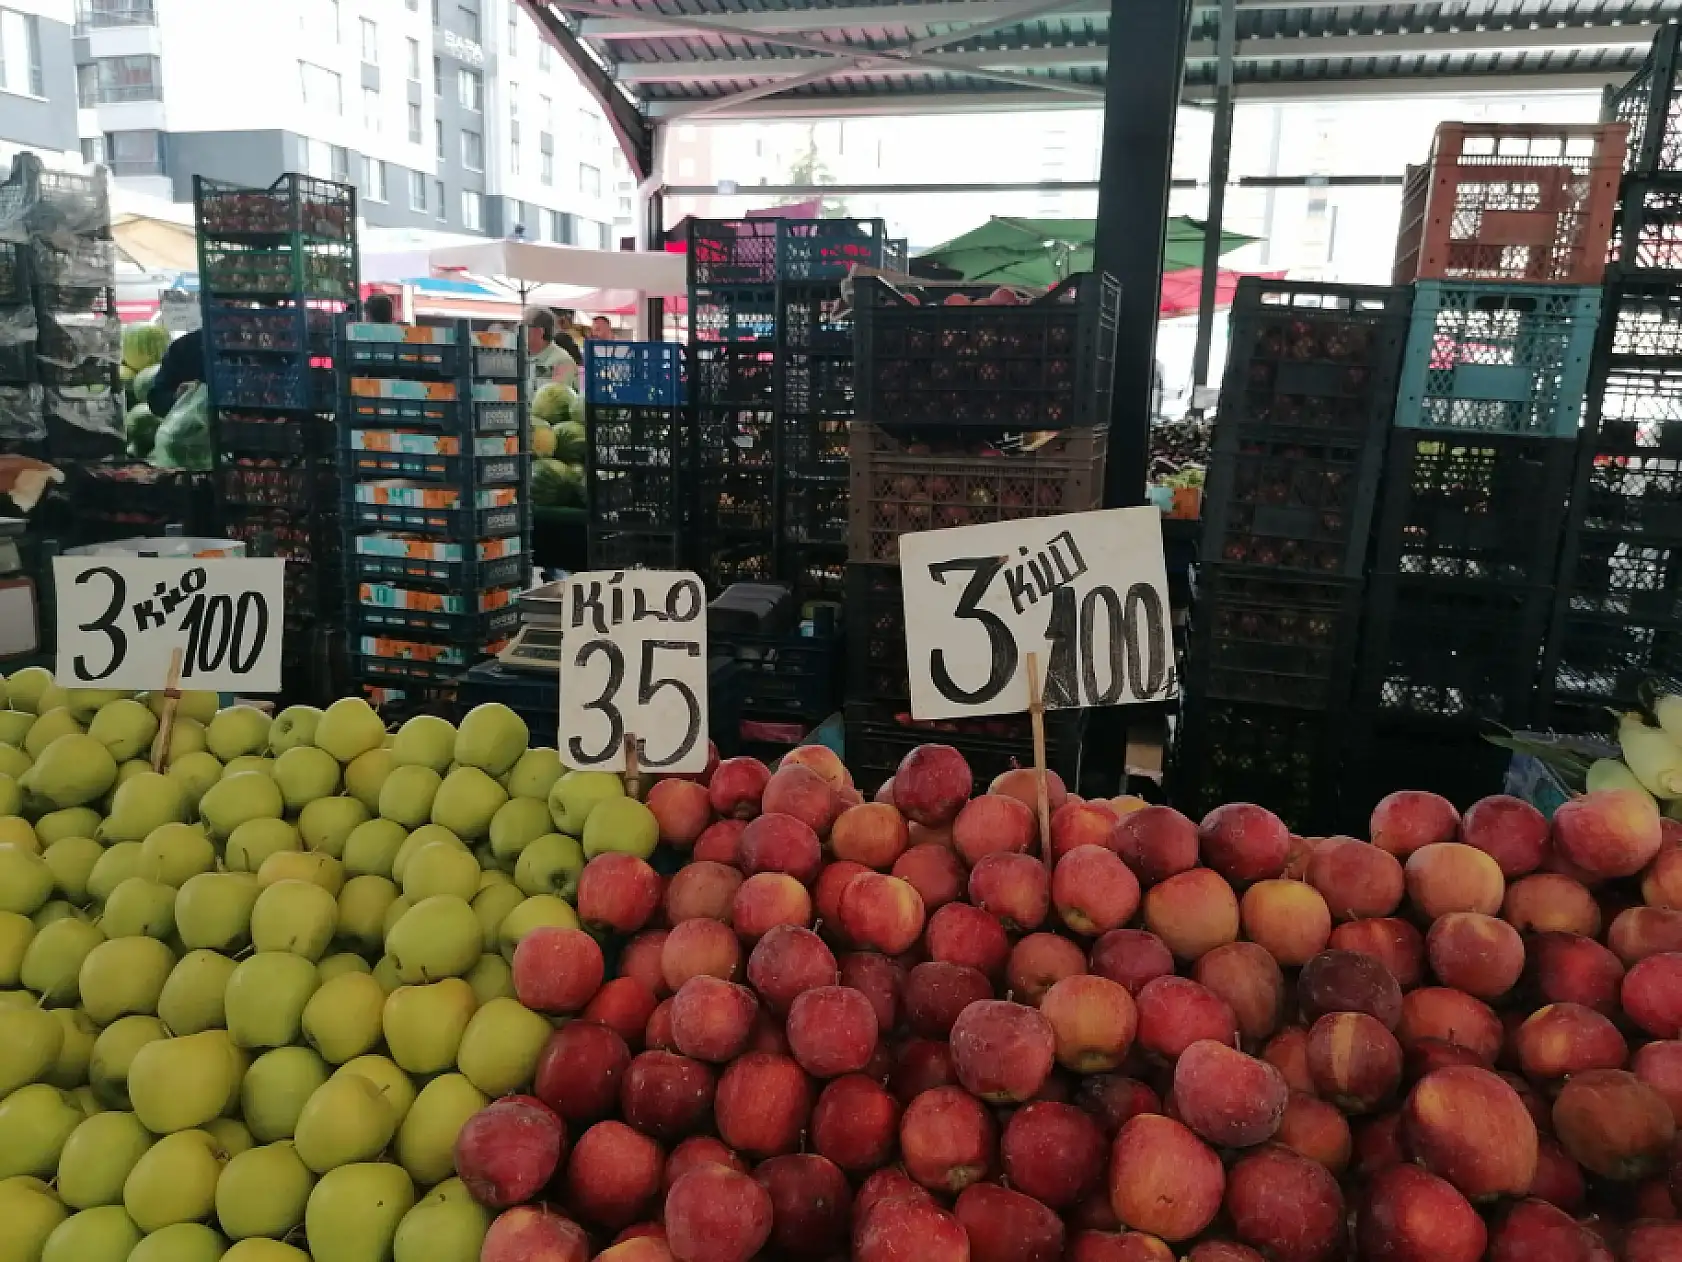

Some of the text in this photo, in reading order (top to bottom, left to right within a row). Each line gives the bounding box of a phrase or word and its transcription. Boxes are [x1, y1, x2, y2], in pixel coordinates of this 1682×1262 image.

[73, 566, 128, 682] 3
[178, 591, 268, 678] 100
[926, 555, 1019, 705] 3
[1041, 582, 1166, 709] 100
[568, 639, 701, 767] 35
